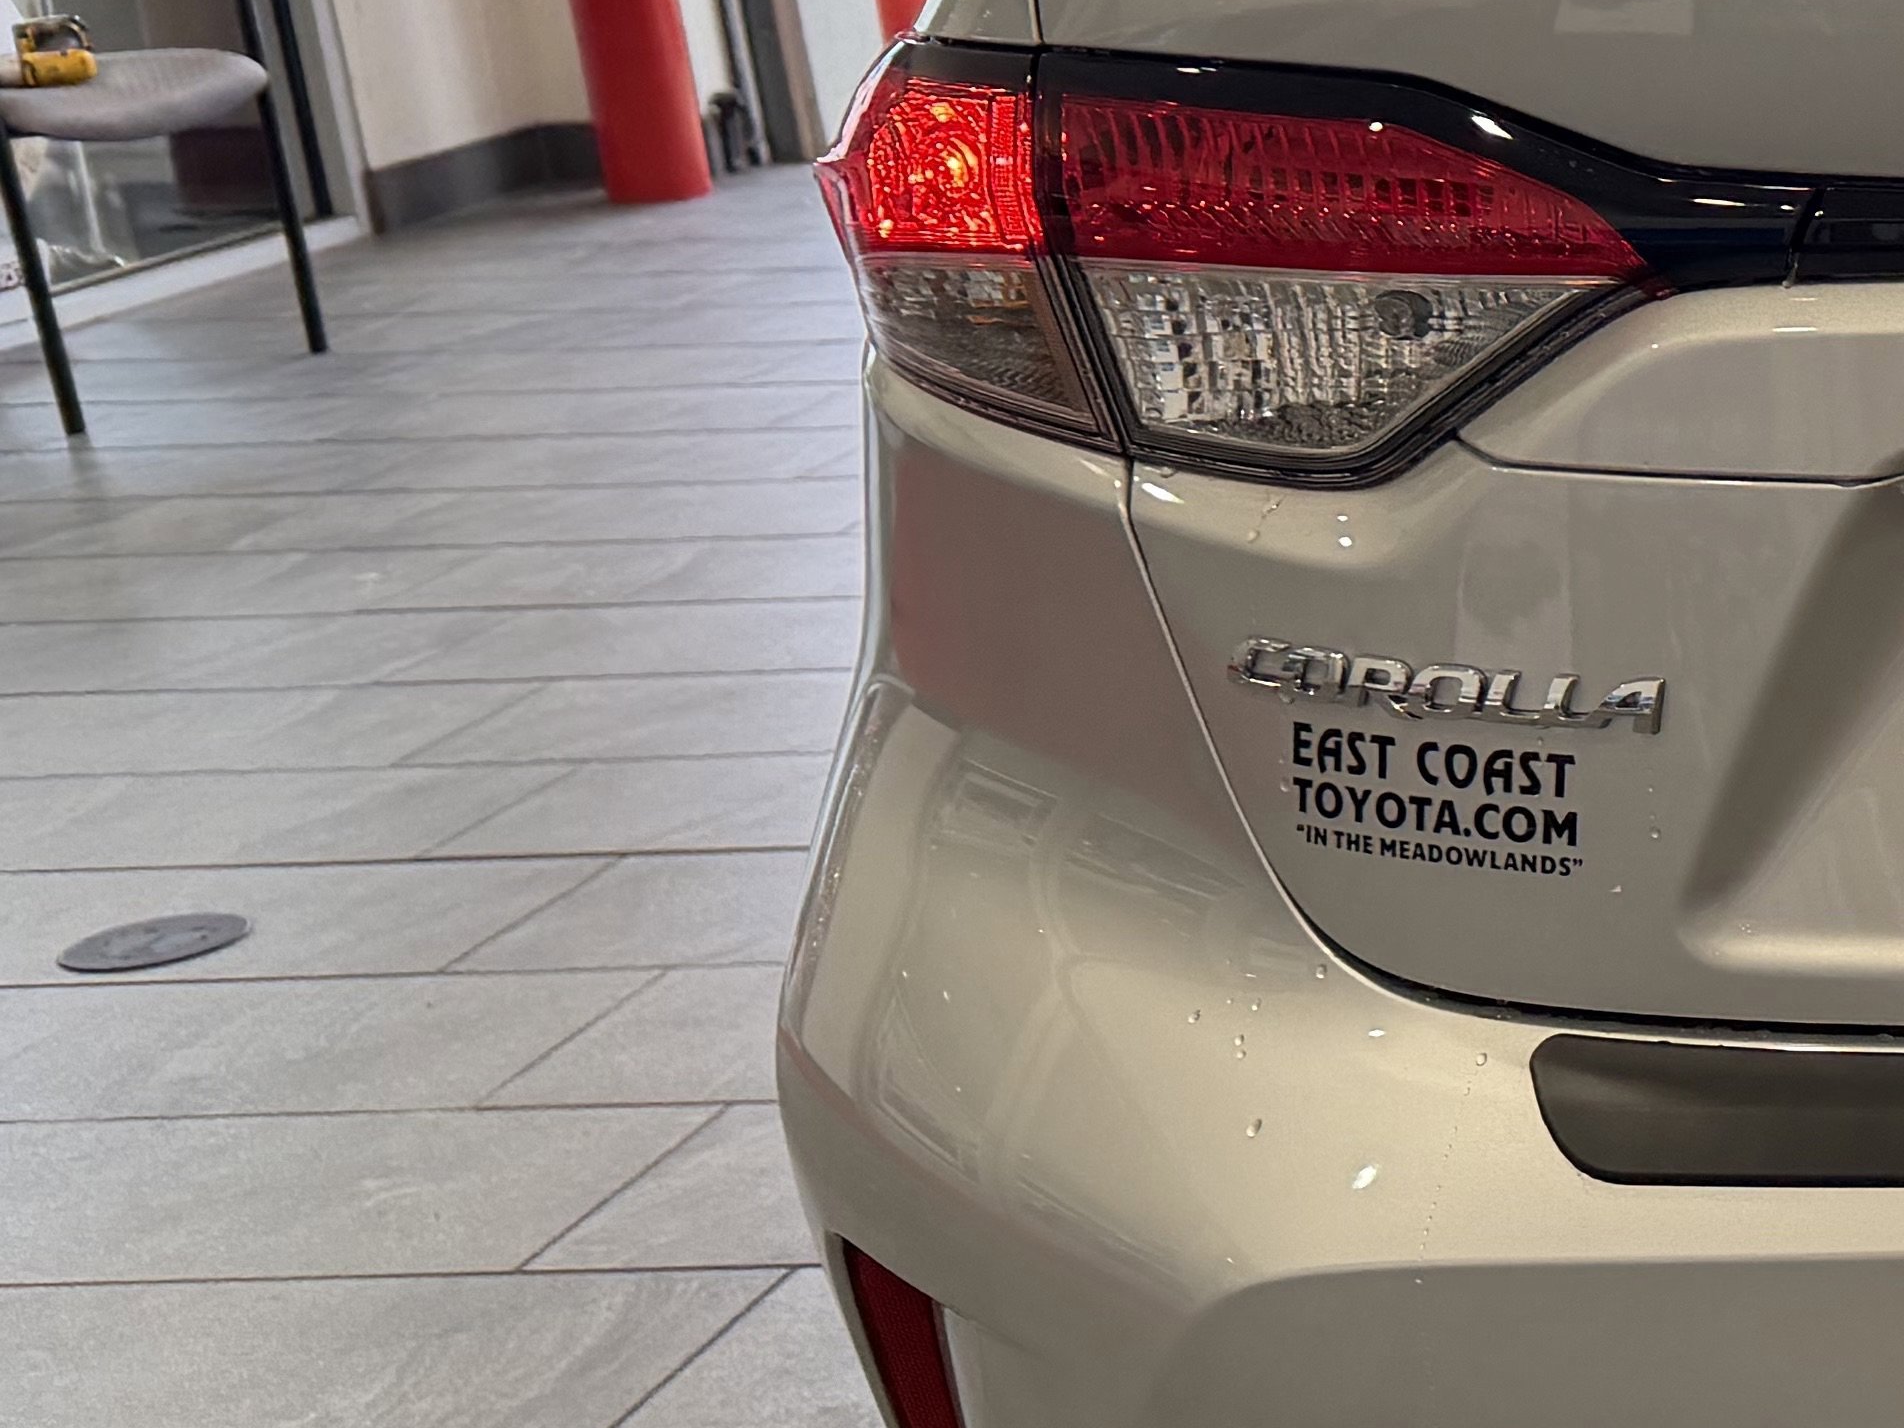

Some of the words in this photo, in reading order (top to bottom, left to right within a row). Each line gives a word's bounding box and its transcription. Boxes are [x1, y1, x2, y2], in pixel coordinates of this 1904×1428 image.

[1228, 636, 1667, 735] COROLLA
[1292, 721, 1396, 780] EAST
[1417, 741, 1576, 798] COAST
[1293, 777, 1579, 847] TOYOTA.COM
[1333, 830, 1373, 855] THE
